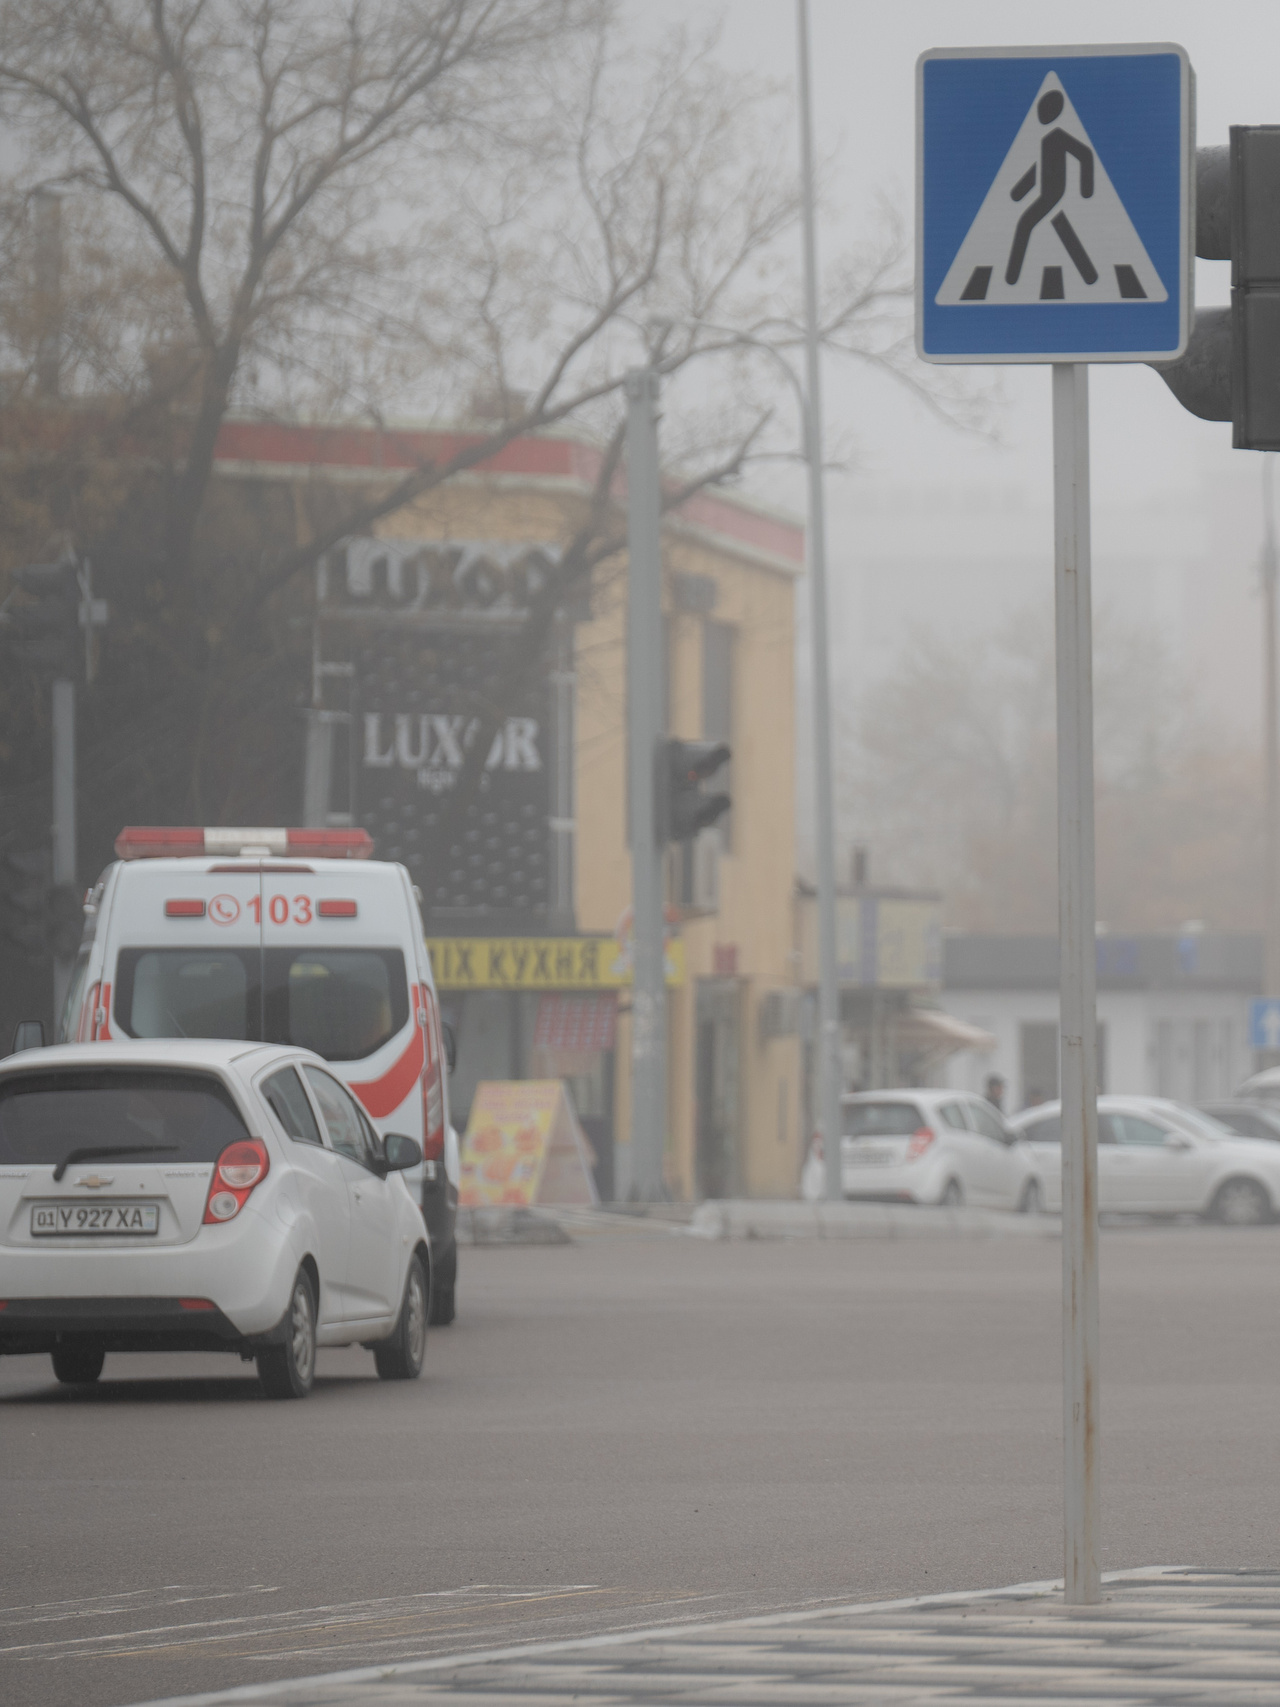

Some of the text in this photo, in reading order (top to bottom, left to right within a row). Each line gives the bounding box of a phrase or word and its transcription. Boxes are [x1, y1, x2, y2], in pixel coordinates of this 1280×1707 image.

[247, 894, 312, 925] 103
[489, 942, 600, 980] КУХНЯ
[37, 1208, 143, 1228] 01 Y 927 XA
